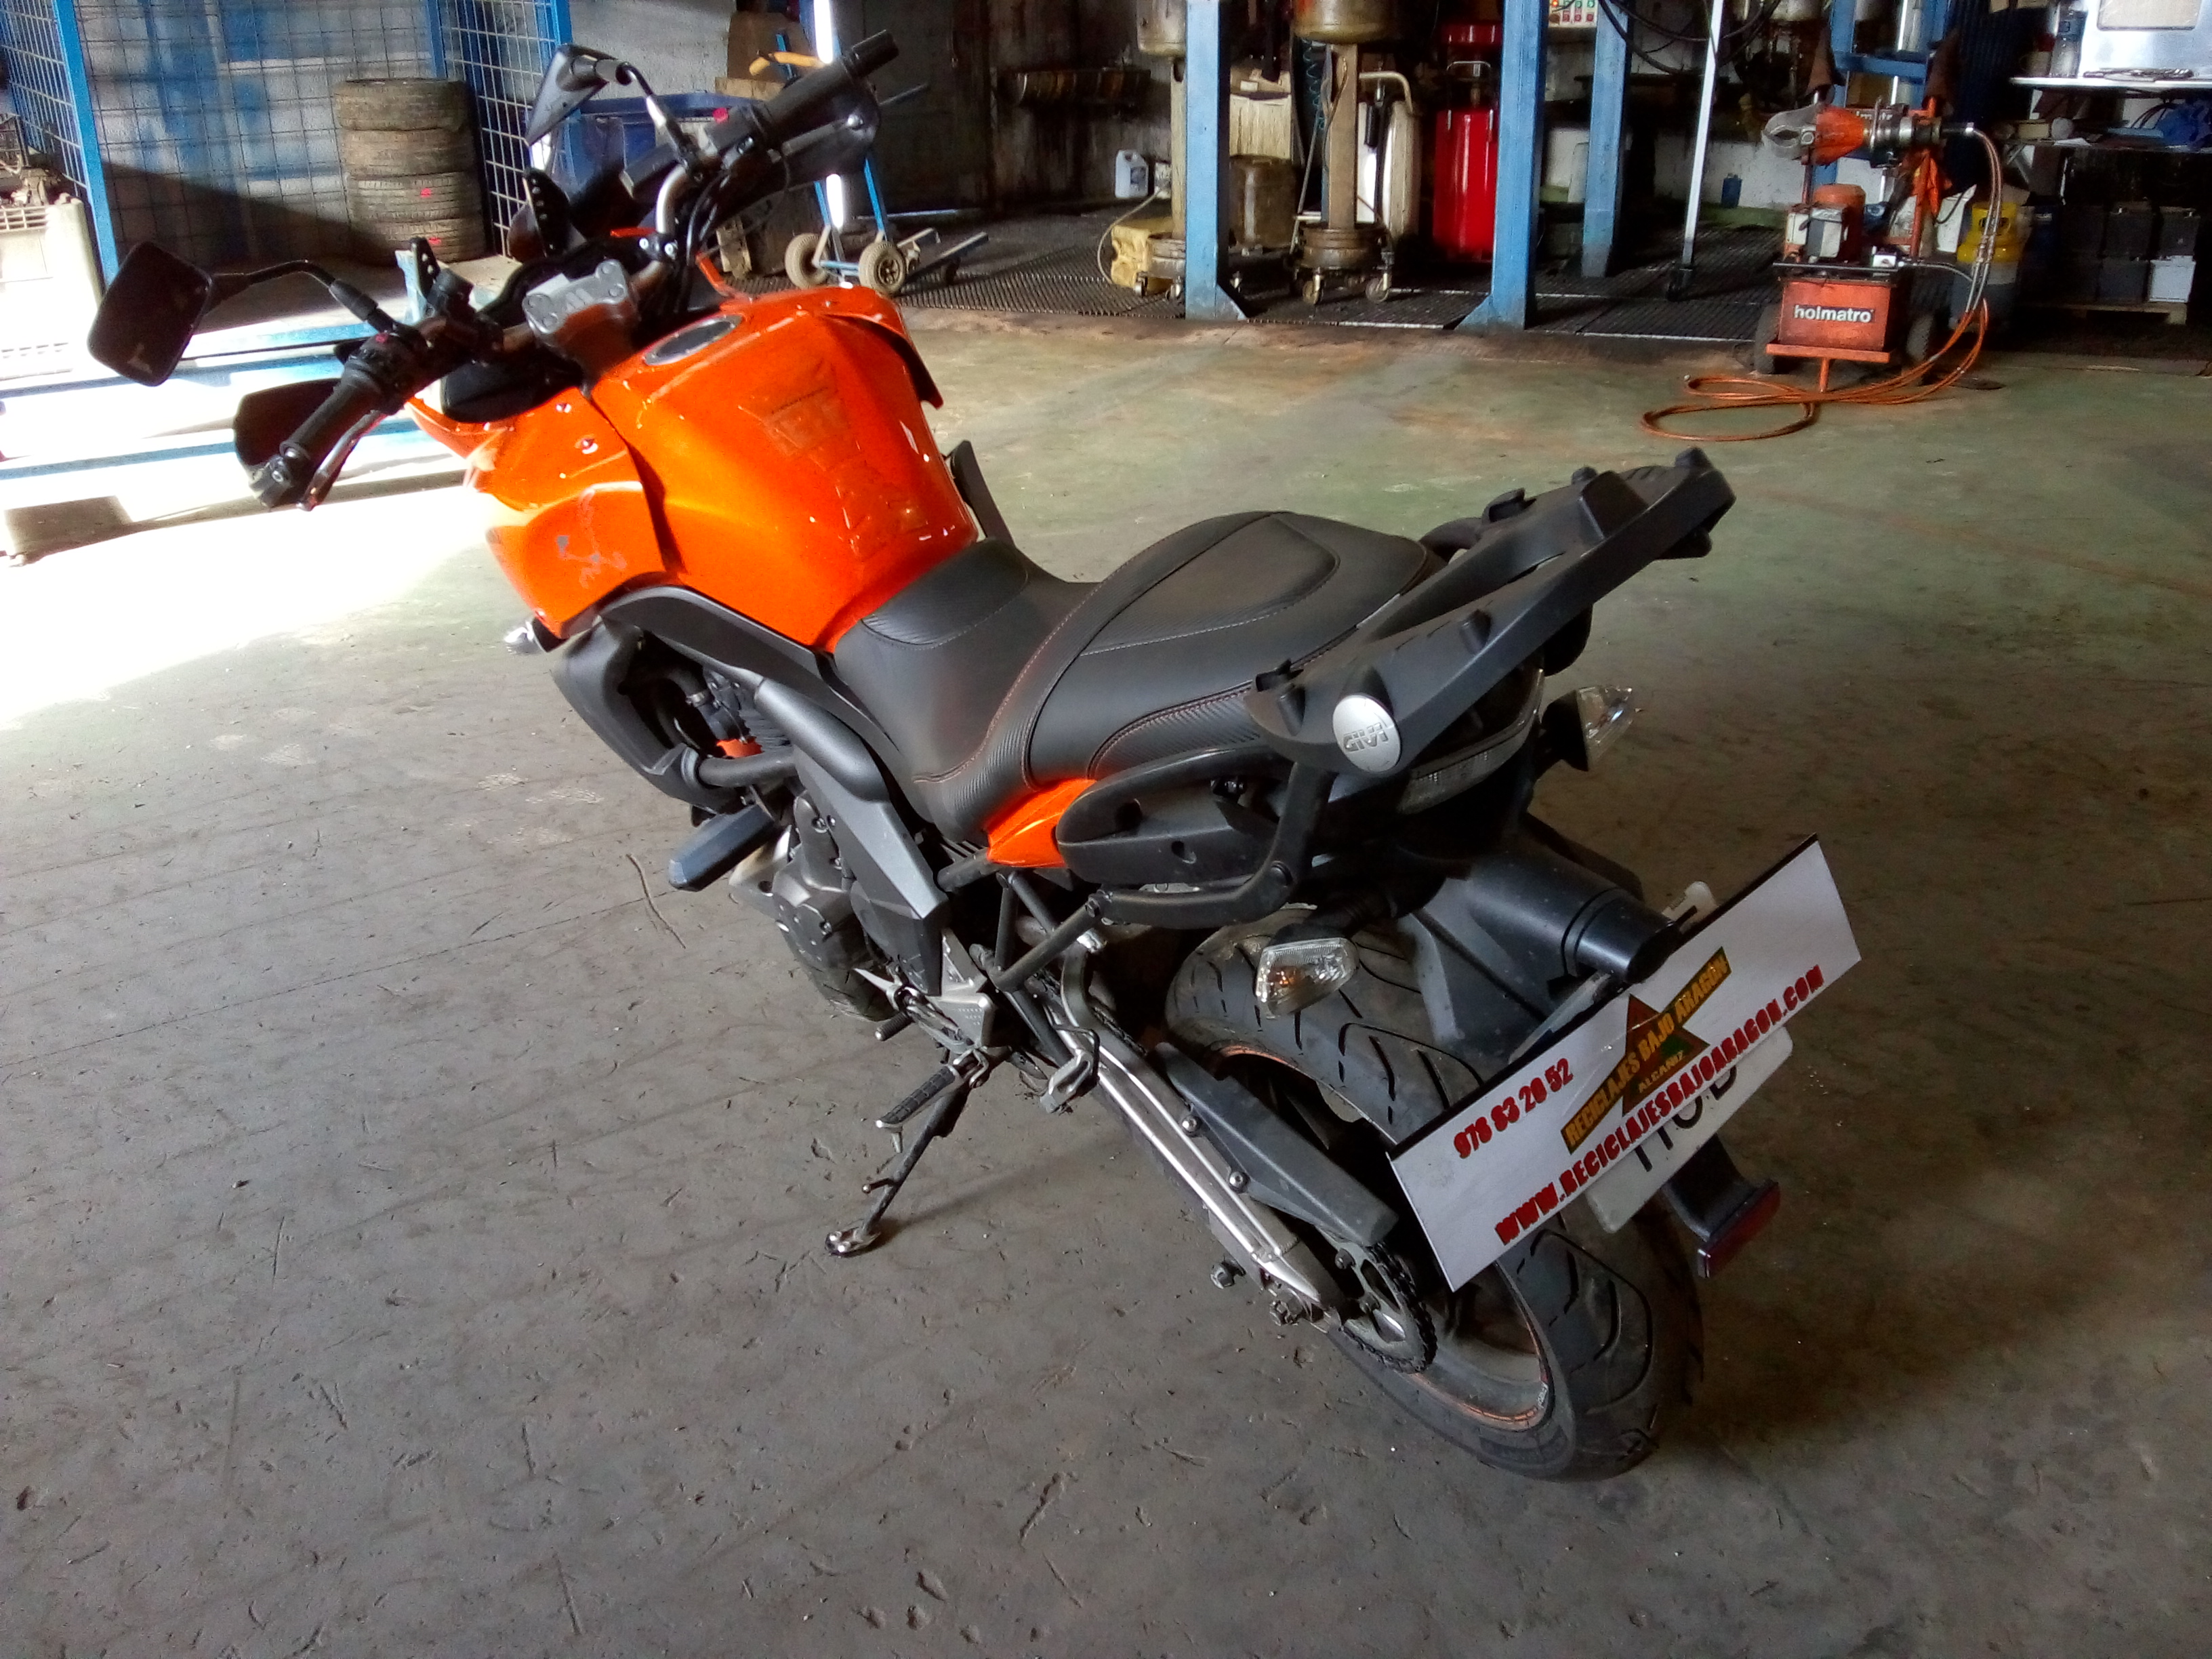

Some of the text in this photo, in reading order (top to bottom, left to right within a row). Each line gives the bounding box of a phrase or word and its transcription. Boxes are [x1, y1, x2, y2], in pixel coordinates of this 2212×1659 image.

[1793, 304, 1872, 323] holmatro
[1343, 722, 1389, 752] GIVI
[1454, 1058, 1574, 1160] 978 83 20 52
[1564, 1052, 1641, 1147] RECICLAJES
[1638, 1012, 1675, 1061] BAJO
